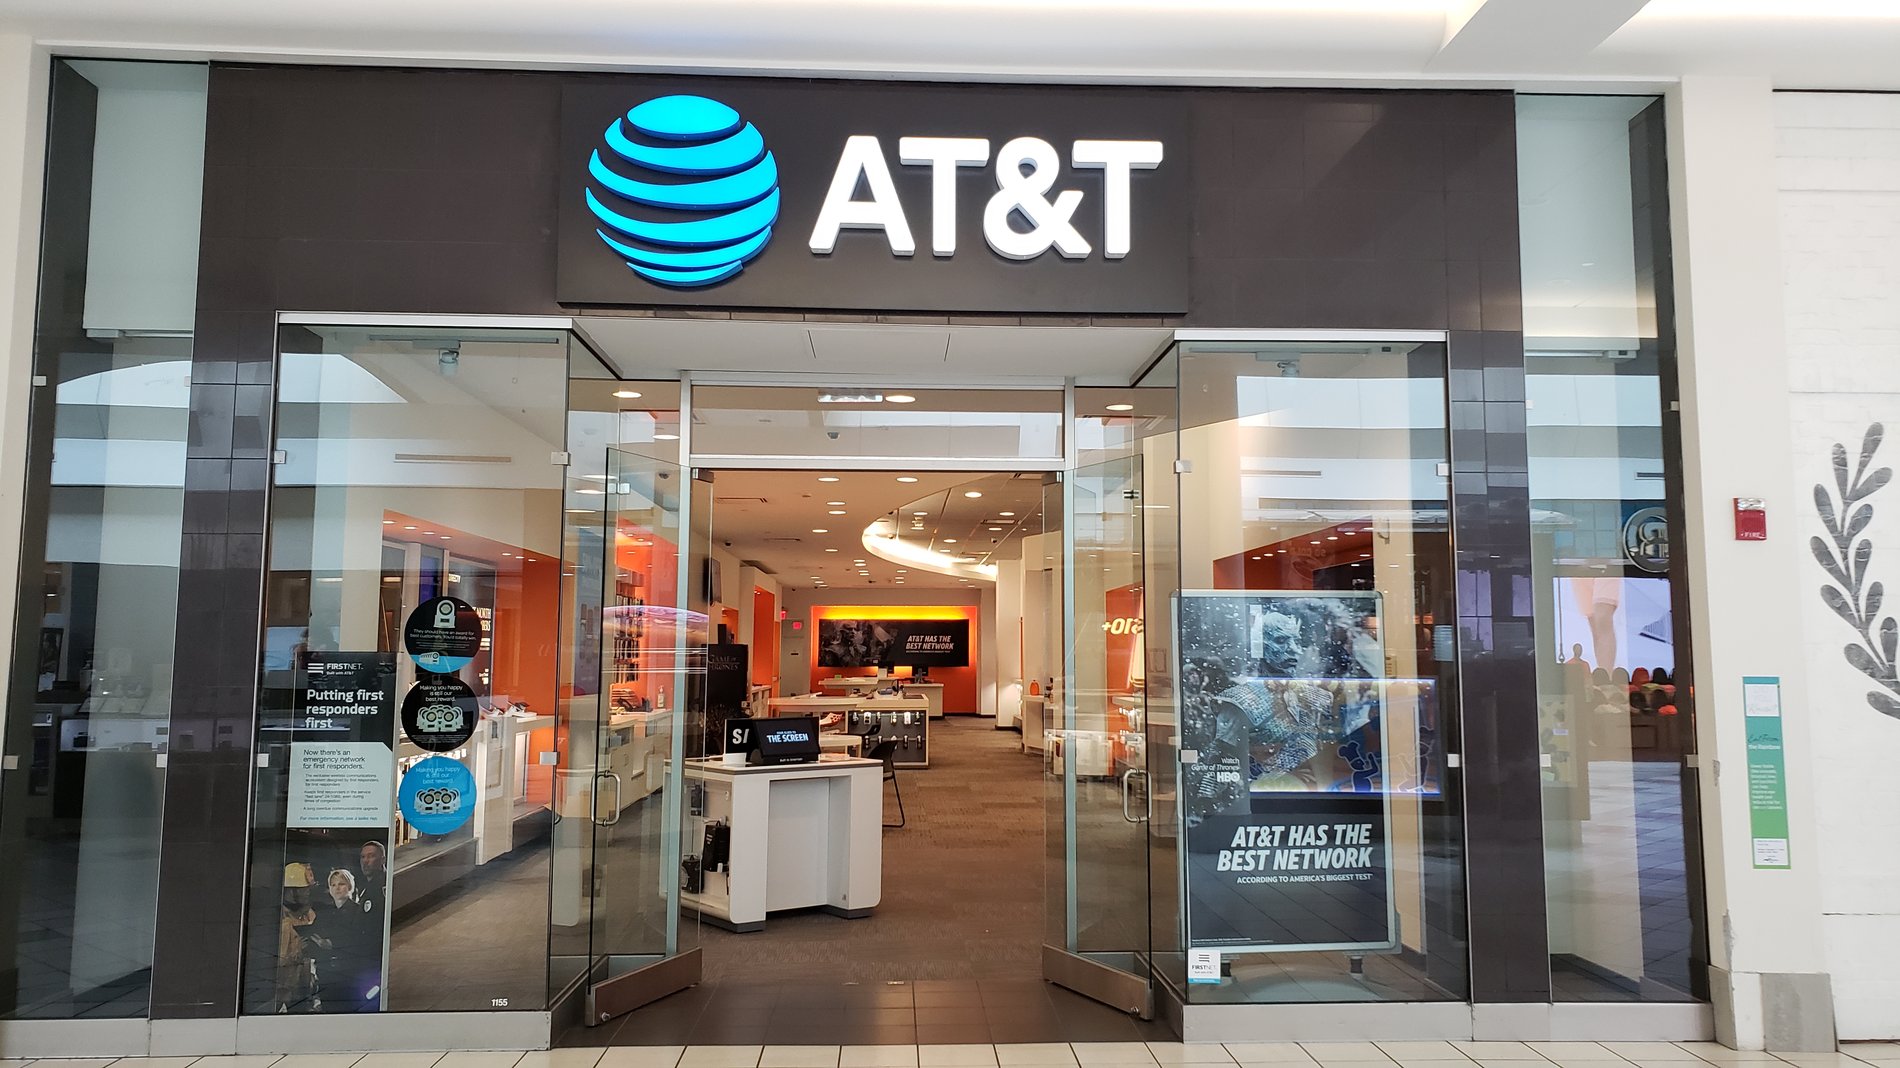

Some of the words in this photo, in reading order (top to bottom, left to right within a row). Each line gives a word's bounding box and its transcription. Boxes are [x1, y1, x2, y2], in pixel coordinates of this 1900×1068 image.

[809, 135, 1164, 260] AT&T
[905, 642, 922, 650] BEST
[922, 642, 954, 650] NETWORK
[306, 689, 354, 703] Putting
[357, 689, 384, 701] first
[306, 703, 378, 716] responders
[305, 717, 333, 728] first
[766, 734, 782, 743] THE
[782, 733, 809, 742] SCREEN
[1216, 772, 1240, 782] HBO
[1230, 826, 1286, 848] AT&T
[1287, 824, 1329, 846] HAS
[1333, 823, 1373, 845] THE
[1216, 849, 1270, 871] BEST
[1272, 847, 1374, 870] NETWORK
[1237, 876, 1278, 884] ACCORDING
[1278, 875, 1289, 883] TO
[1289, 875, 1326, 883] AMERICA'S
[1326, 874, 1354, 882] BIGGEST
[1355, 873, 1373, 881] TEST
[491, 999, 508, 1007] 1155
